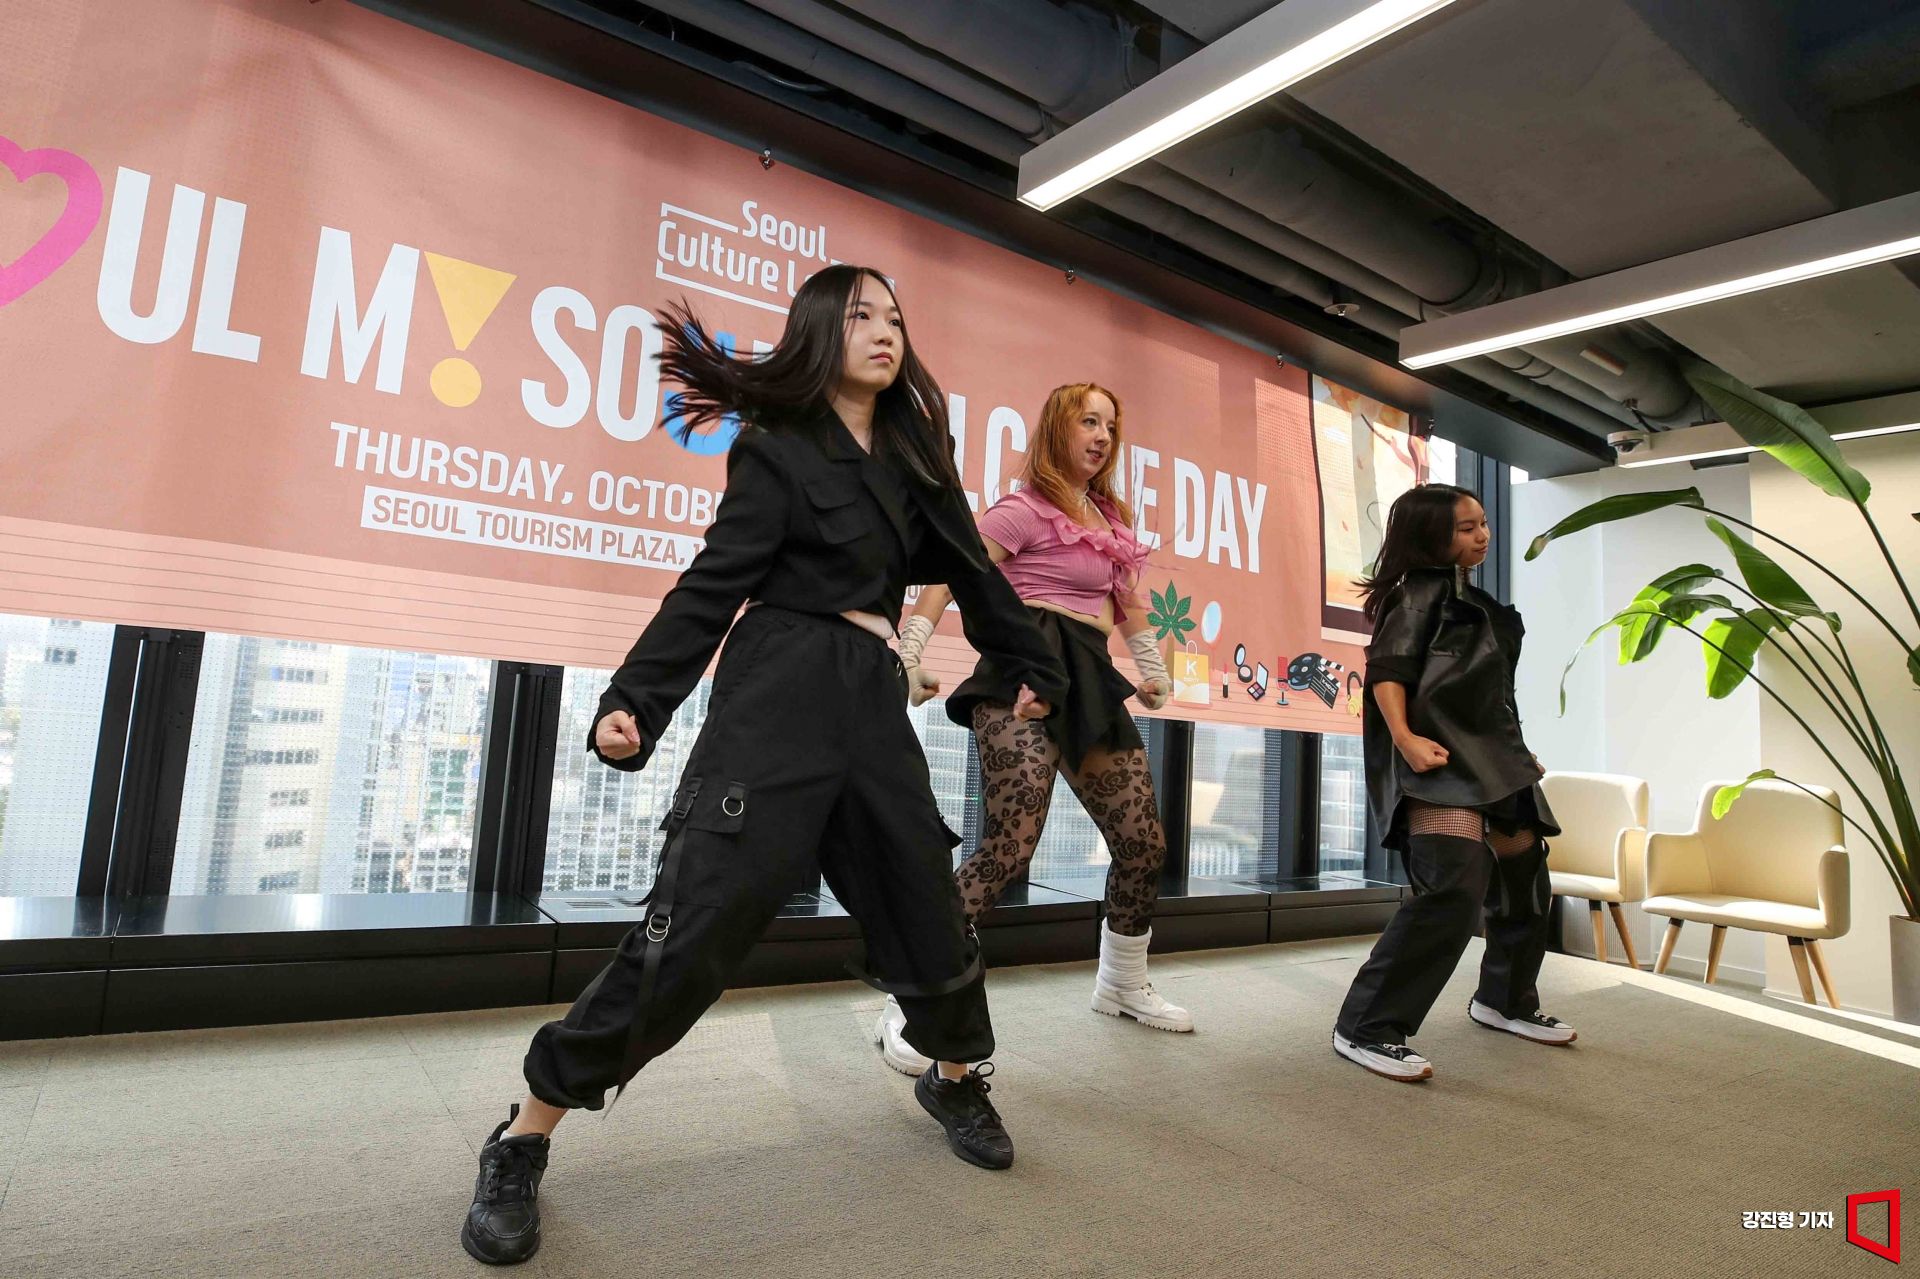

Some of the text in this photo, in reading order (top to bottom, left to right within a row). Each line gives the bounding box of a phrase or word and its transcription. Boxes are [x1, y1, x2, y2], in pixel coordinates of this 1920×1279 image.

[657, 220, 779, 293] Culture
[742, 200, 827, 263] Seoul
[330, 421, 574, 505] THURSDAY,
[521, 286, 738, 456] SO
[1174, 456, 1268, 574] DAY
[371, 494, 686, 566] SEOUL TOURISM PLAZA,
[1186, 659, 1197, 676] K
